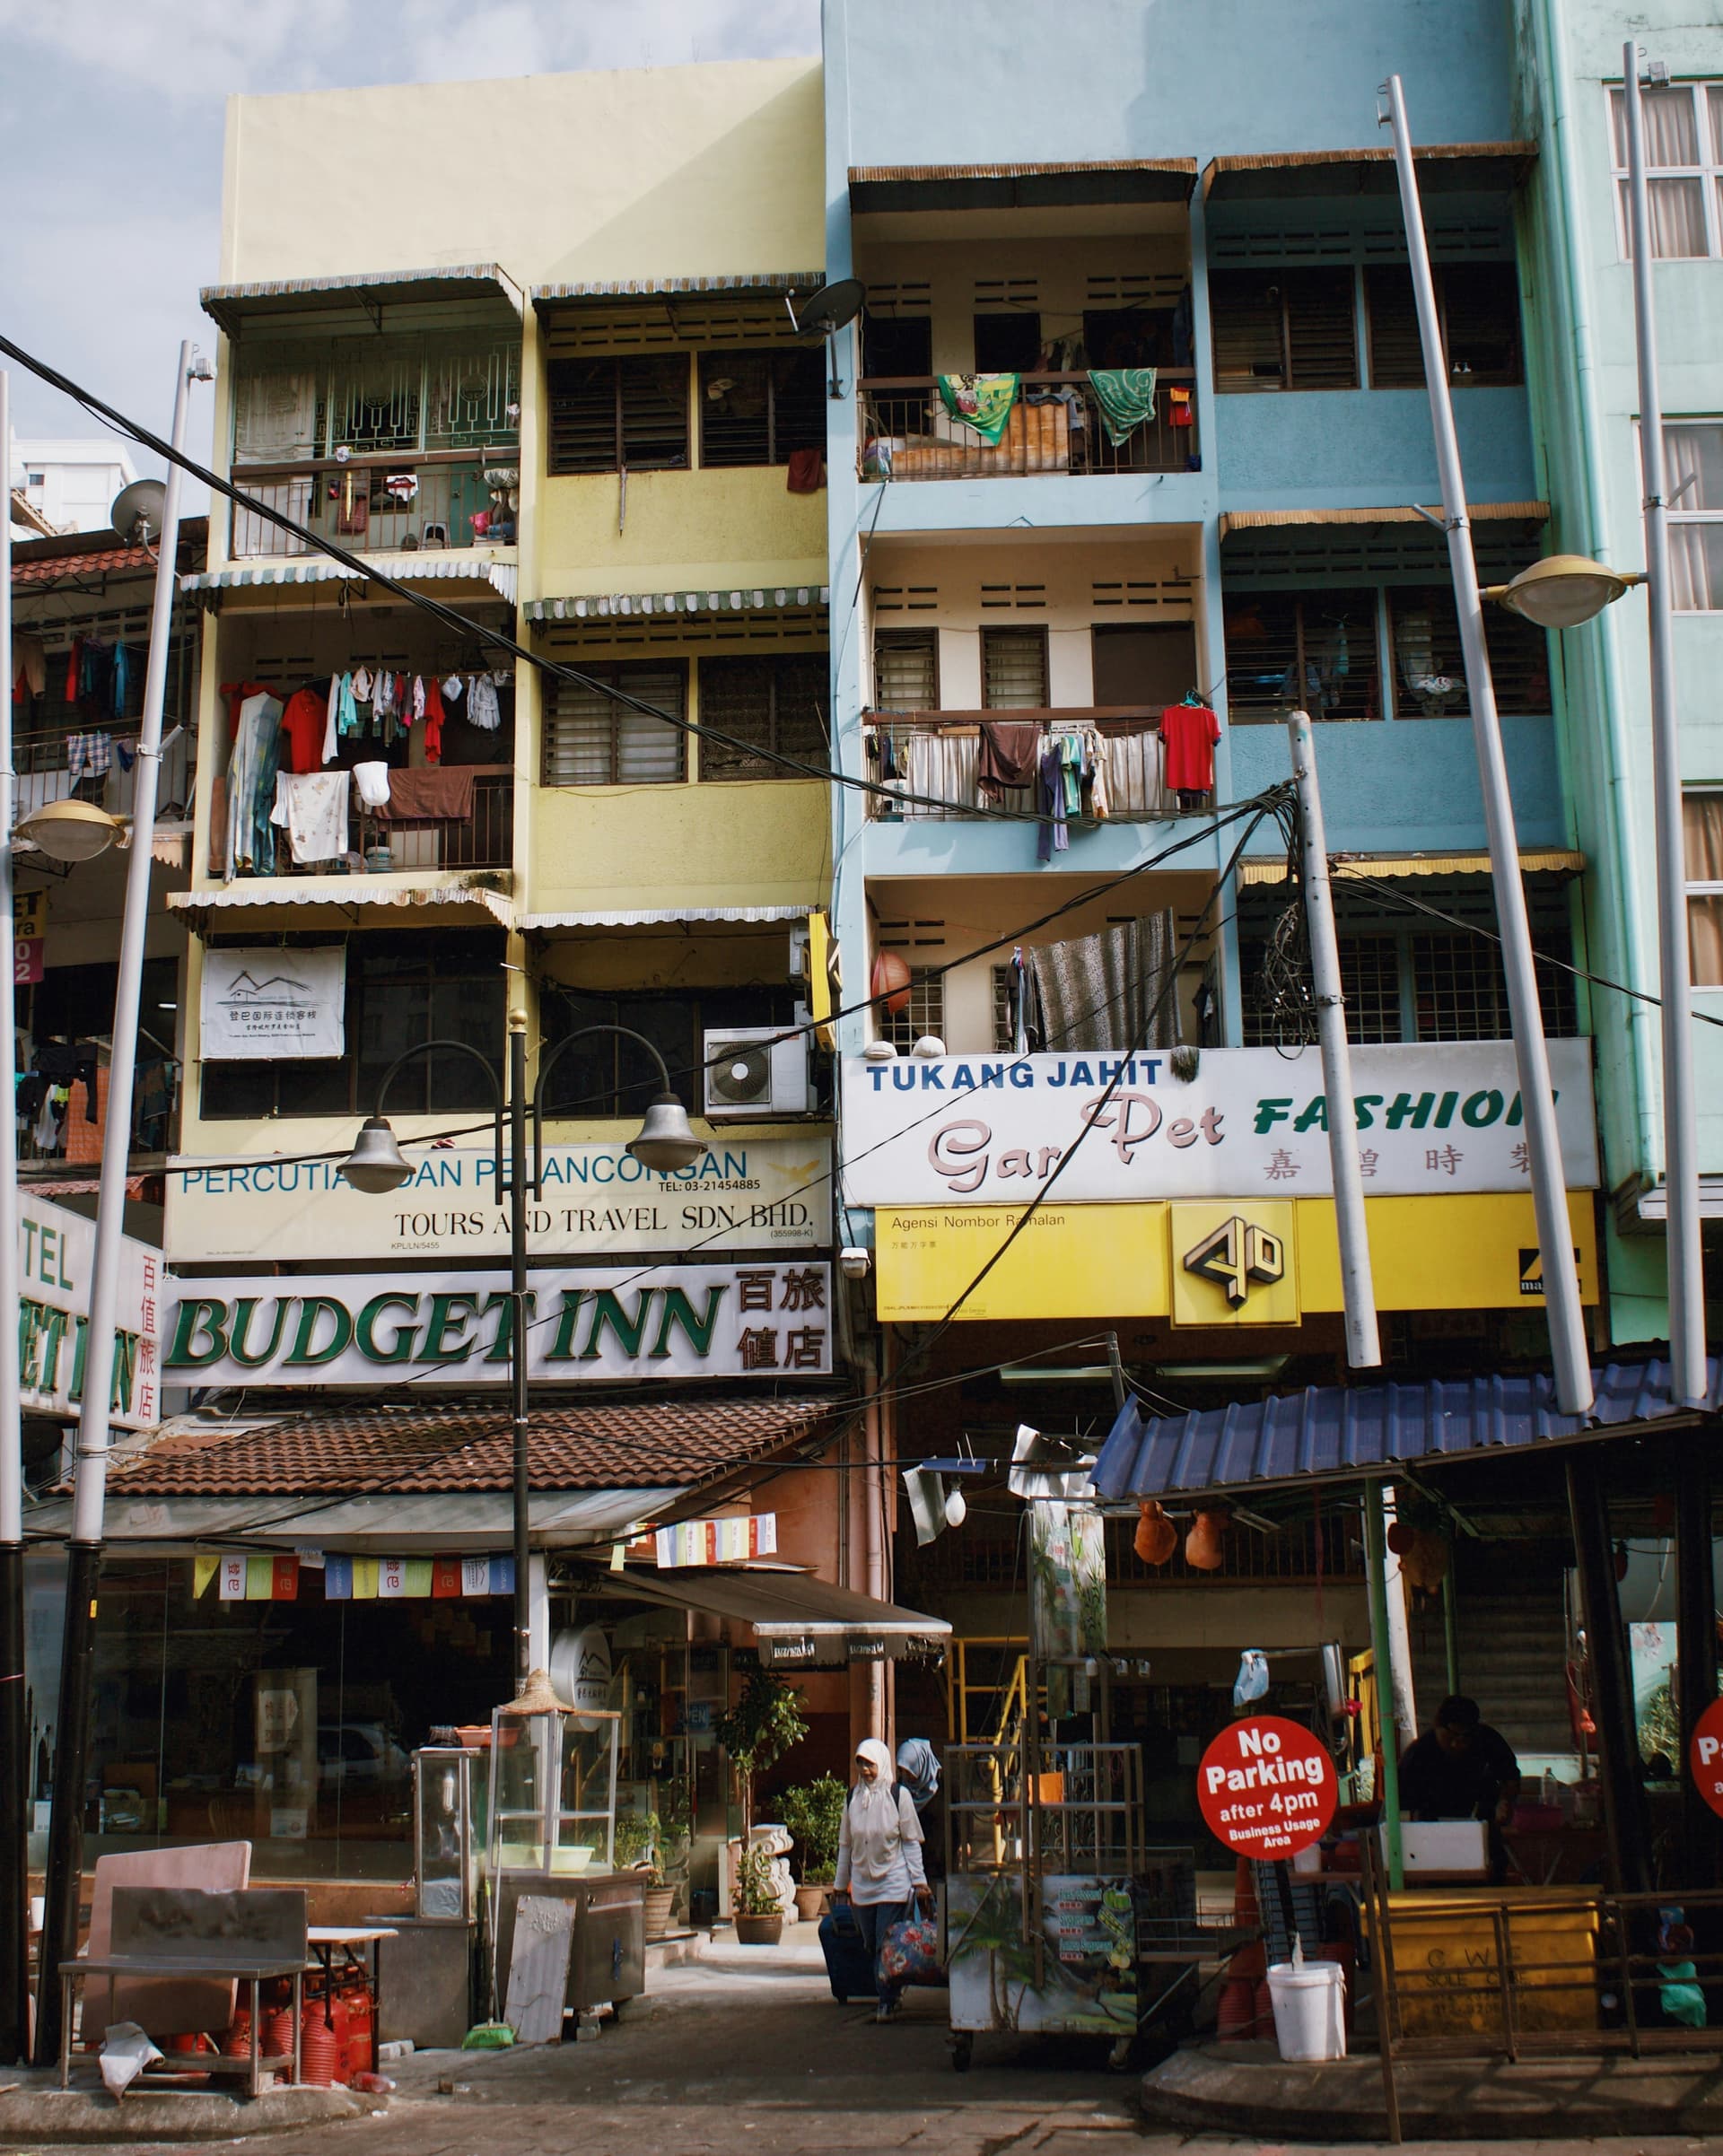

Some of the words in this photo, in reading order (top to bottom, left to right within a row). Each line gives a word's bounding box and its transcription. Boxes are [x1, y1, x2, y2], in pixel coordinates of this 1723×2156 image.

[866, 1063, 1035, 1091] TUKANG
[1047, 1060, 1163, 1088] JAHIT
[927, 1119, 1063, 1193] Gar
[658, 1182, 683, 1192] TEL:
[685, 1179, 761, 1191] 03-21454885
[394, 1211, 485, 1236] TOURS
[561, 1207, 668, 1233] TRAVEL
[750, 1203, 814, 1228] BHD.
[891, 1217, 939, 1232] Agensi
[944, 1215, 1001, 1228] Nombor
[164, 1290, 538, 1367] BUDGET
[543, 1285, 730, 1361] INN
[1238, 1728, 1281, 1758] No
[1205, 1756, 1325, 1794] Parking
[1220, 1803, 1264, 1822] after
[1269, 1791, 1319, 1816] 4pm
[1229, 1822, 1282, 1841] Business
[1283, 1817, 1321, 1834] Usage
[1263, 1836, 1292, 1849] Area
